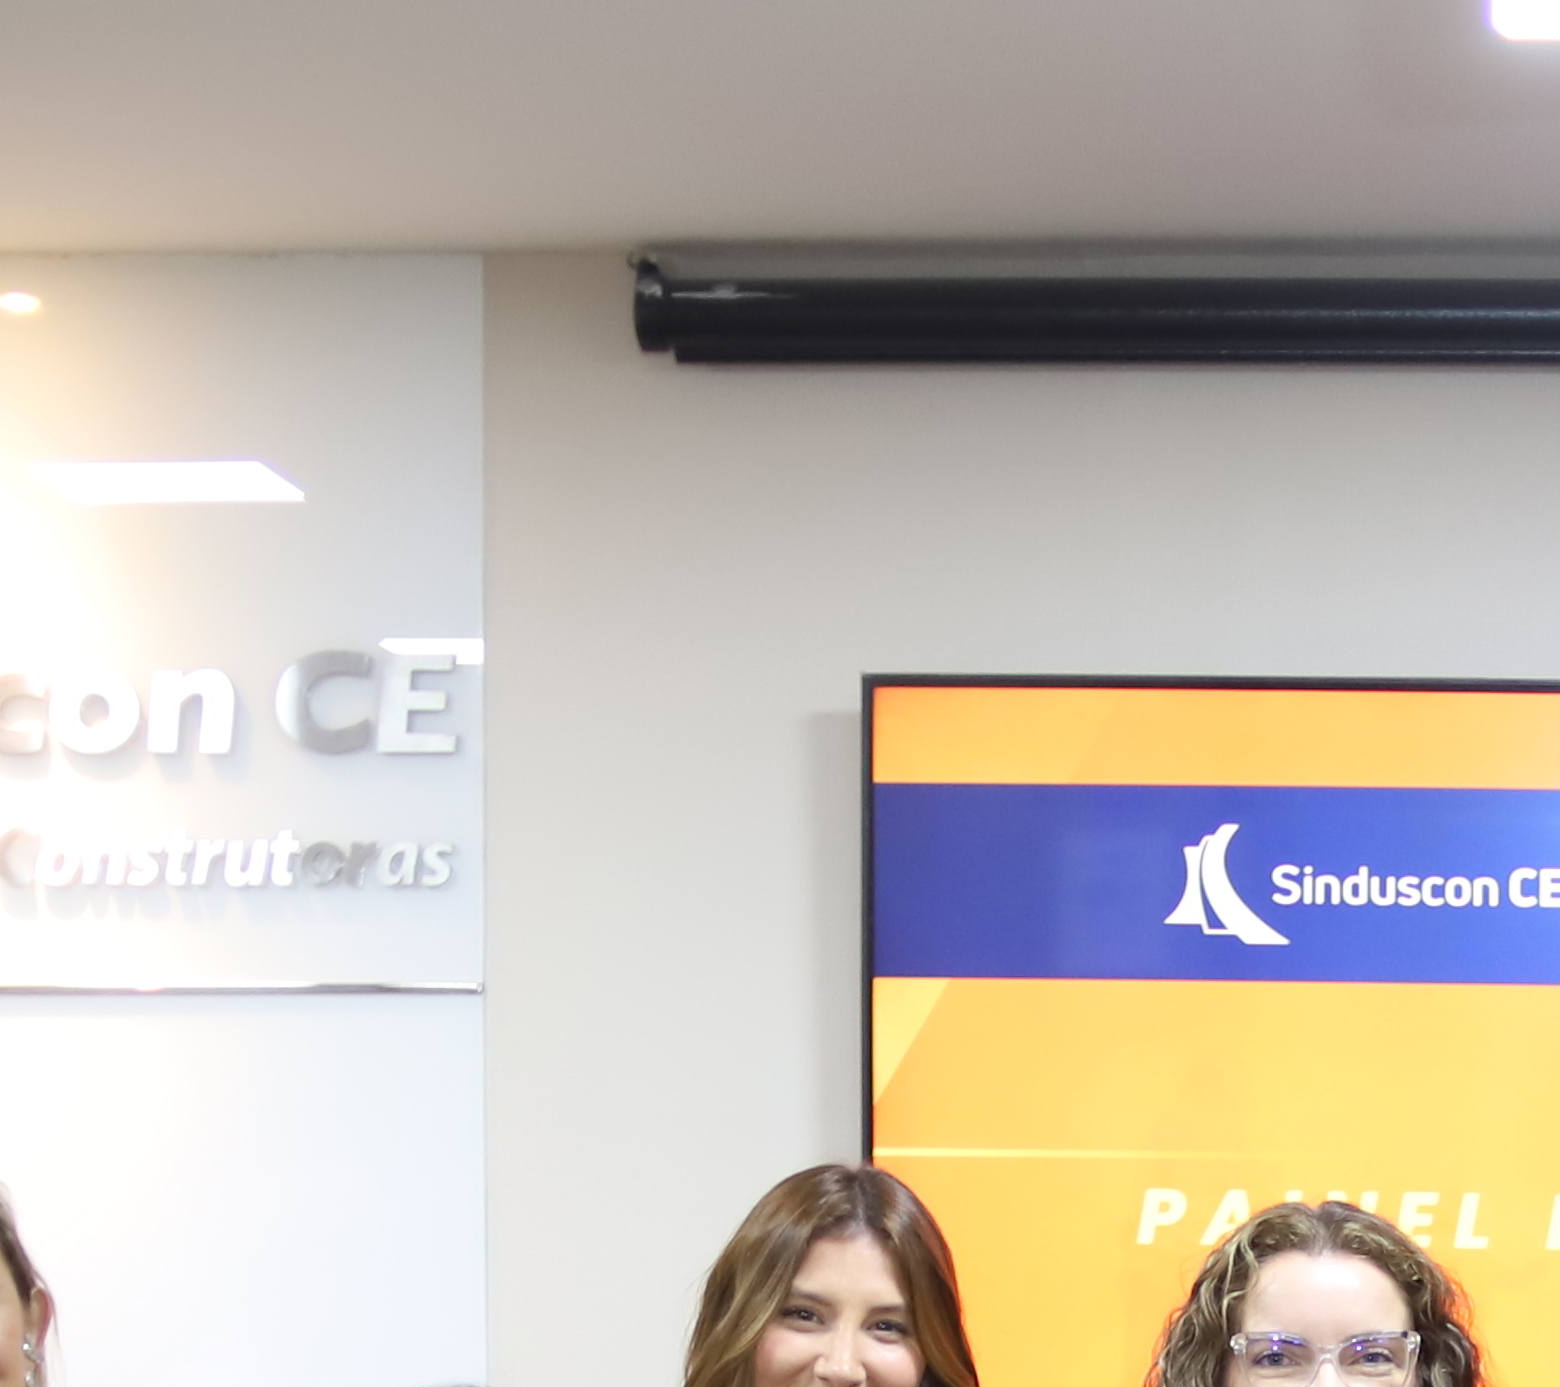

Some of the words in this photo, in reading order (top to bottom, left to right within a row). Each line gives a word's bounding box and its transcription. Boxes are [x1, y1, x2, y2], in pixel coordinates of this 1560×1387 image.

[275, 649, 459, 756] CE
[1271, 864, 1500, 908] Sinduscon
[1135, 1187, 1491, 1251] PAEL
